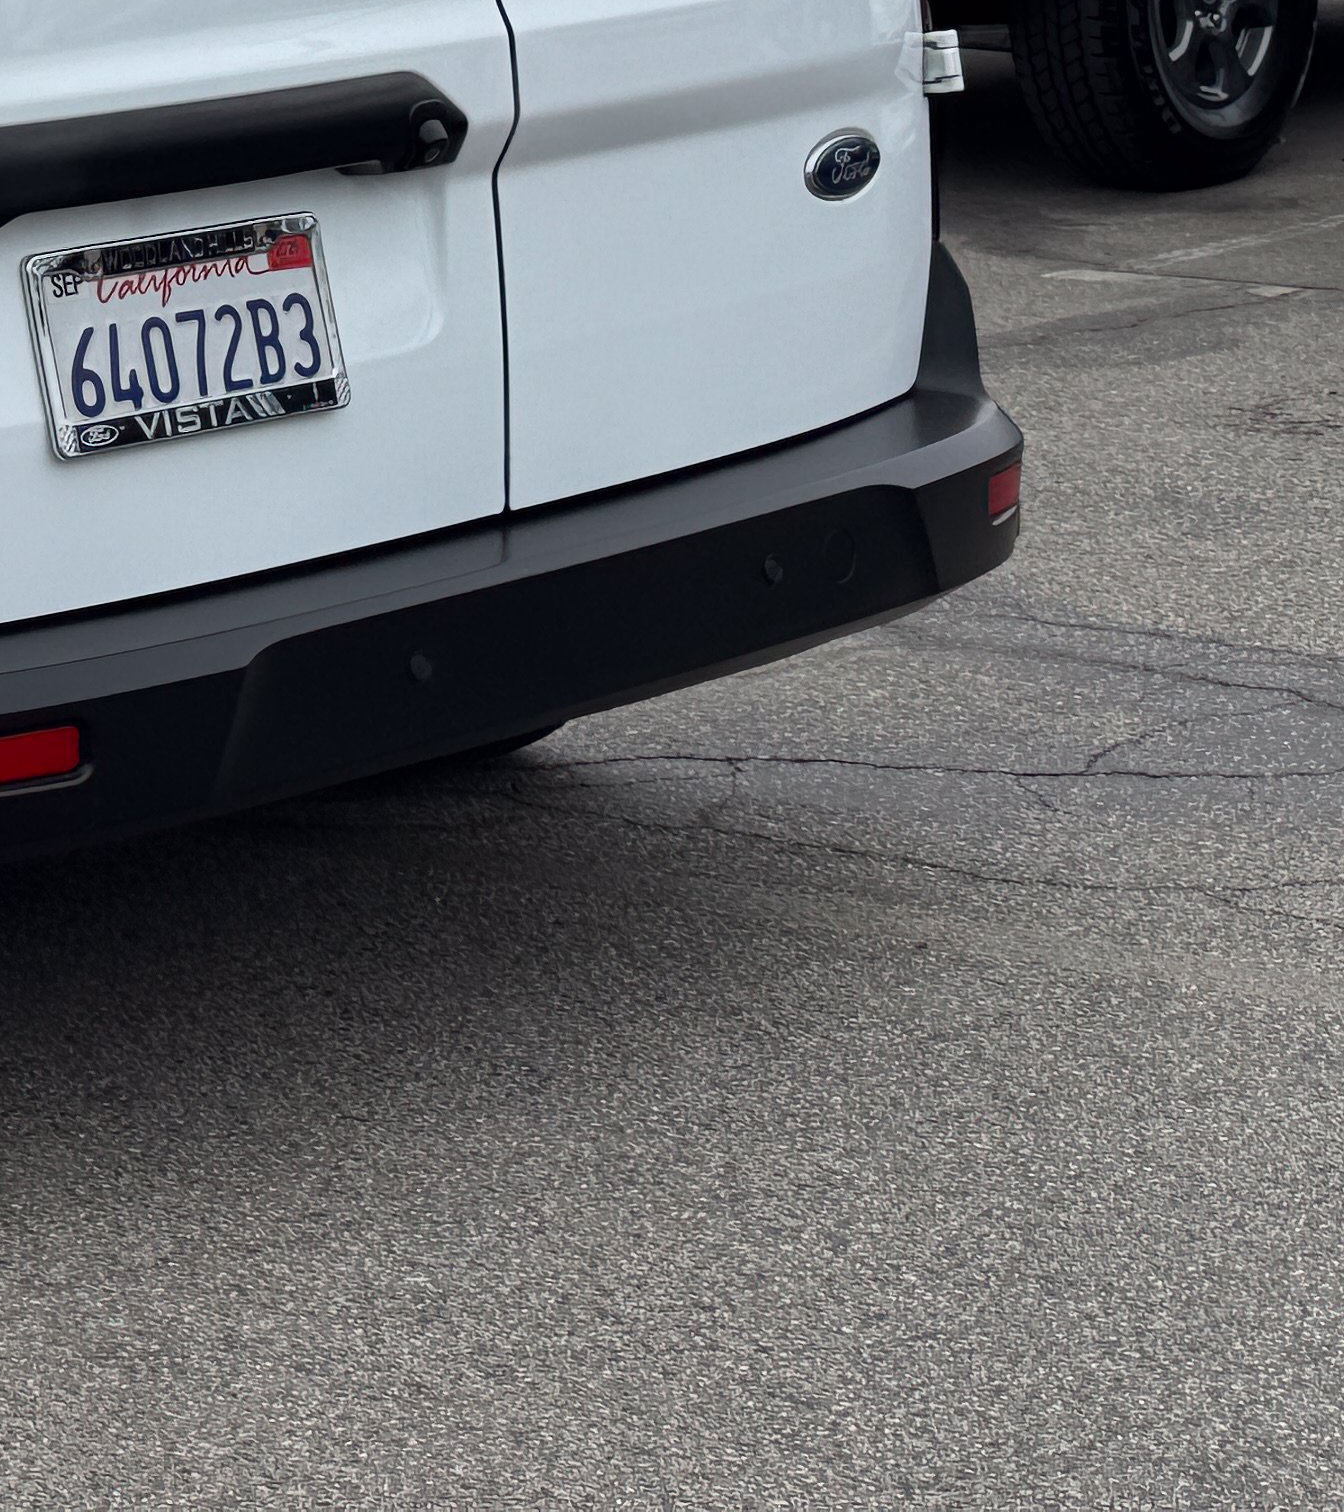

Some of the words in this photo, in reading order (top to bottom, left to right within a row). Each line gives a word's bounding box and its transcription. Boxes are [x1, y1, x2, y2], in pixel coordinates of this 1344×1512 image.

[50, 273, 83, 298] SEP
[71, 292, 322, 418] 64072B3
[134, 397, 257, 440] VISTA
